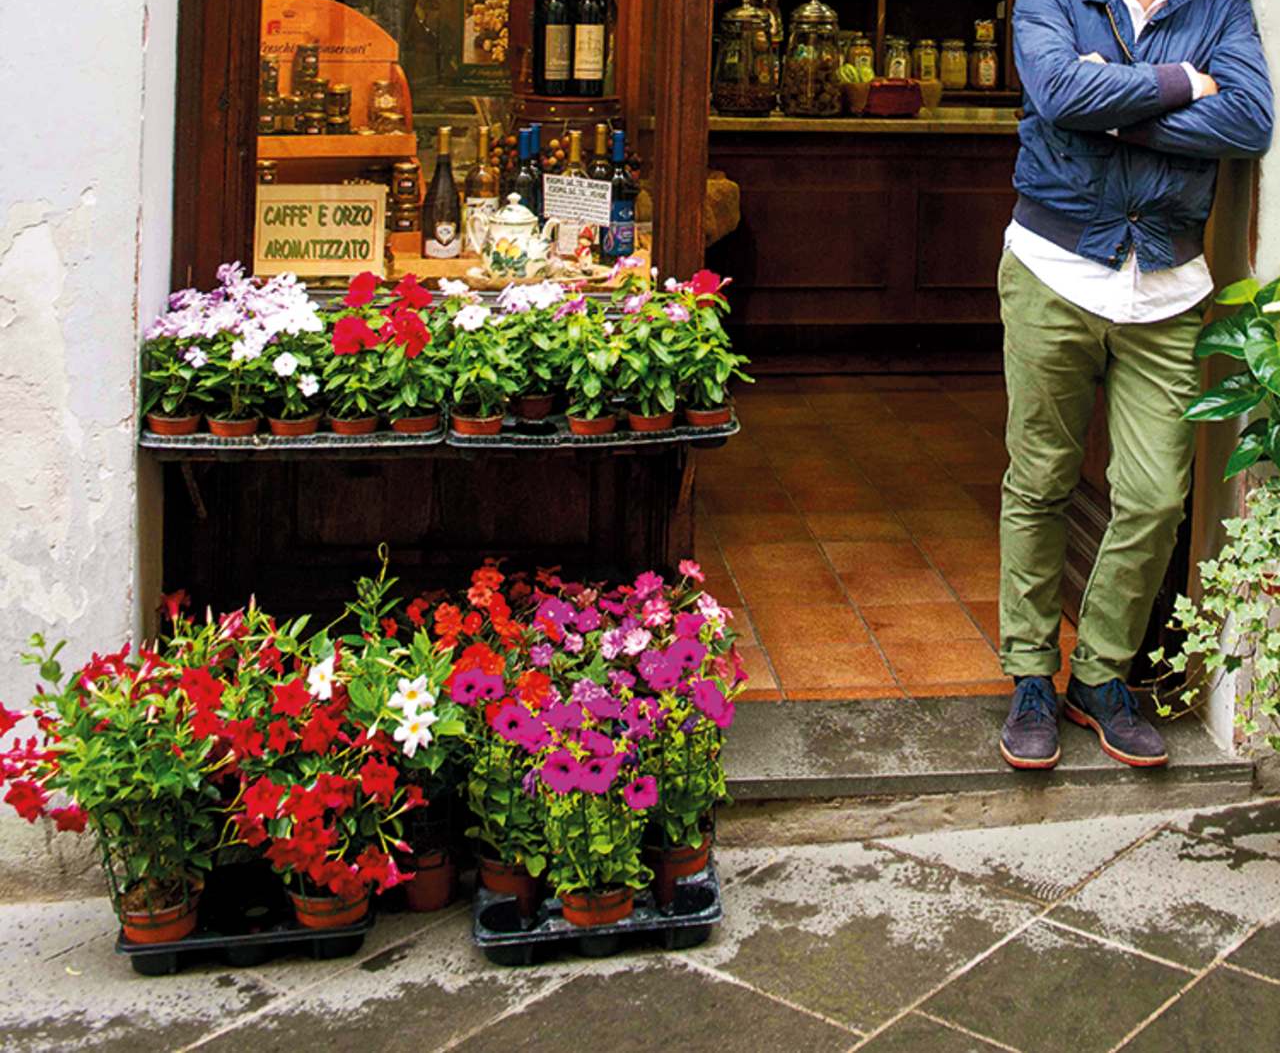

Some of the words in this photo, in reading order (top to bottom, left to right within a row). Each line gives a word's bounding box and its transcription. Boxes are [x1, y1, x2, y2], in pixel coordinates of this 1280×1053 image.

[263, 205, 312, 227] CAFFE'
[318, 204, 328, 227] E
[332, 204, 373, 226] ORZO
[264, 239, 370, 260] AROMATIZZATO
